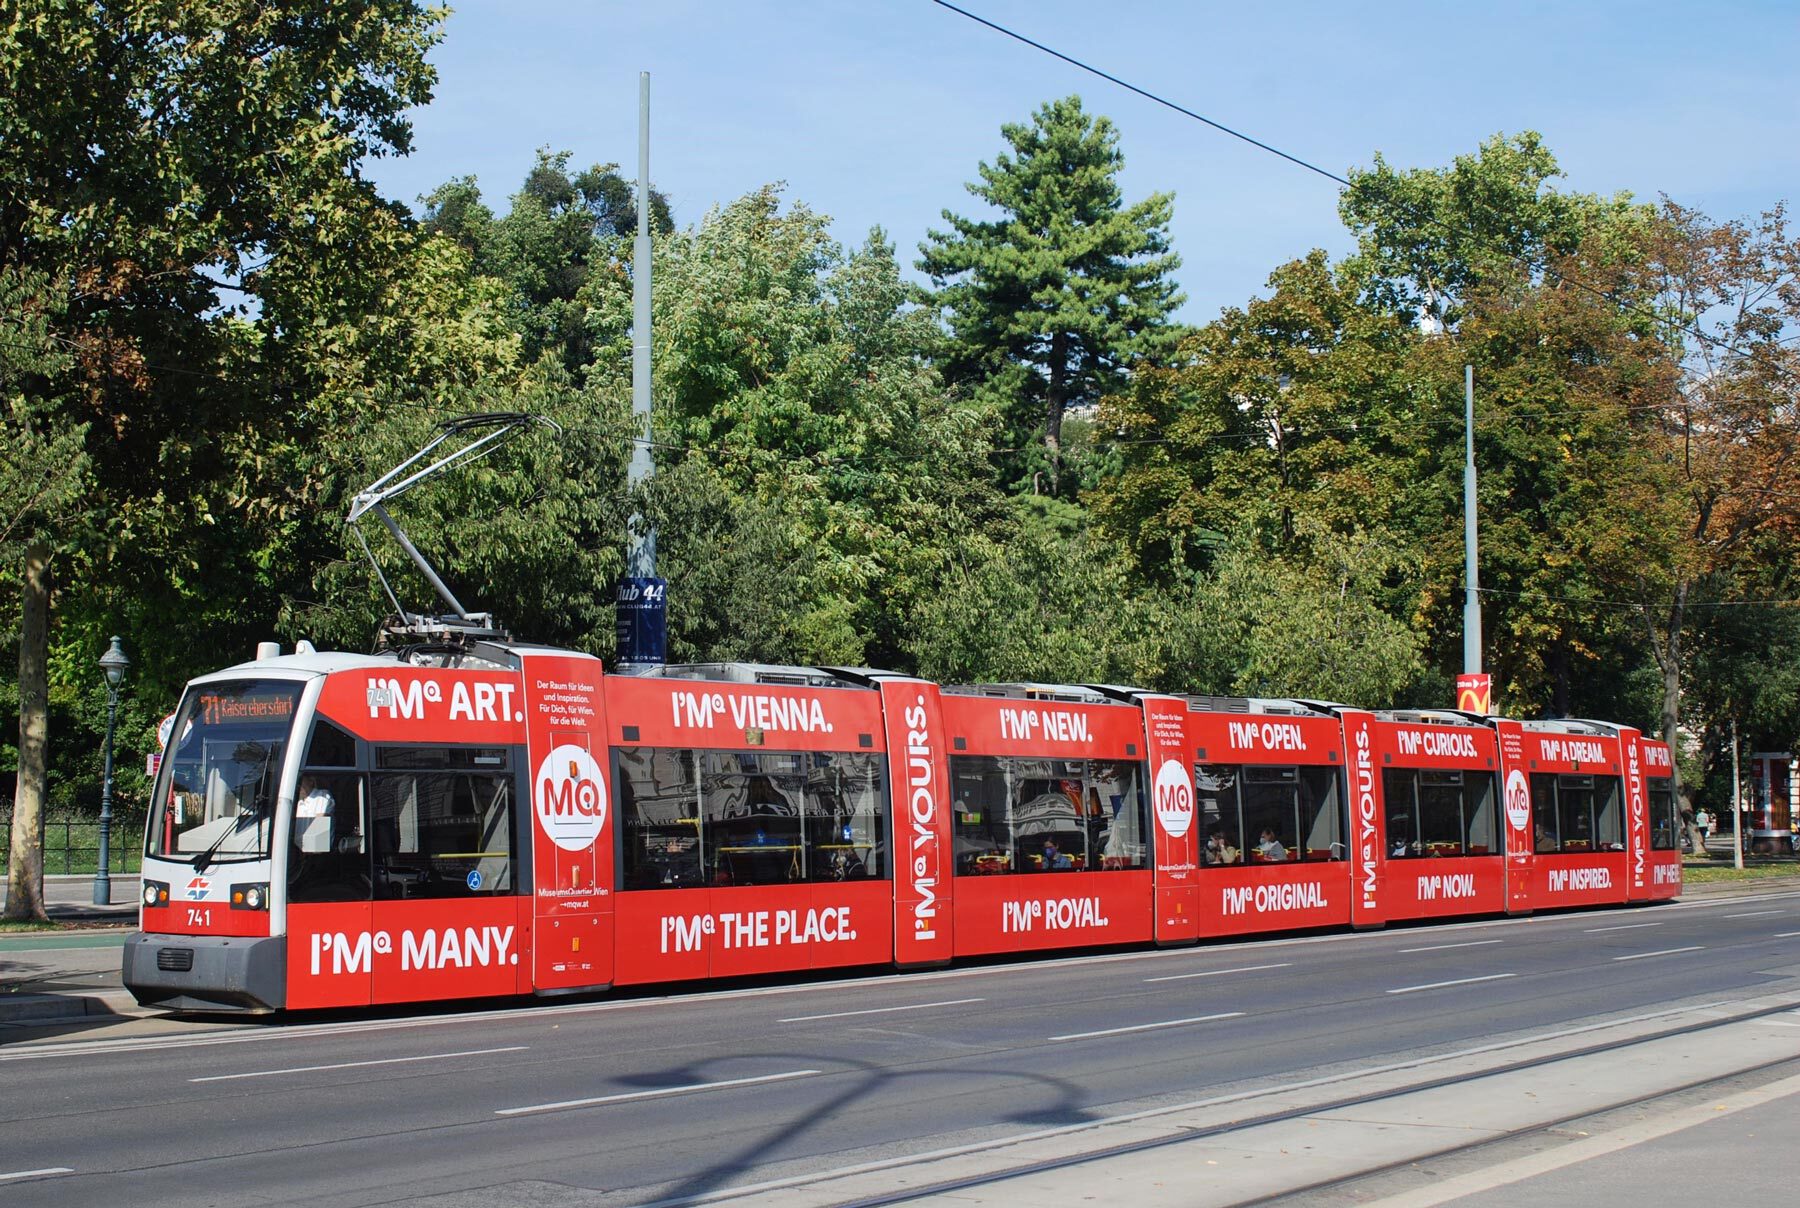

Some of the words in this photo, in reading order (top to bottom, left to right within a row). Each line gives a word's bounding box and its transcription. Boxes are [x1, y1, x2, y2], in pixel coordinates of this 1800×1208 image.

[643, 584, 663, 601] 44
[367, 689, 392, 705] 741
[537, 680, 548, 689] Der
[550, 681, 567, 690] Raum
[568, 682, 577, 691] für
[578, 683, 594, 692] Ideen
[544, 693, 556, 701] und
[557, 693, 590, 704] Inspiration.
[201, 695, 220, 725] 71
[222, 696, 293, 717] Kaiserebersdorf
[450, 682, 523, 722] ART.
[539, 704, 550, 712] Für
[551, 705, 567, 714] Dich,
[568, 705, 577, 714] für
[577, 706, 595, 716] Wien,
[728, 695, 833, 733] VIENNA.
[550, 716, 559, 725] für
[560, 716, 570, 725] die
[571, 717, 587, 727] Welt.
[1042, 711, 1092, 742] NEW.
[1262, 724, 1306, 750] OPEN.
[1424, 732, 1477, 757] CURIOUS.
[1562, 741, 1569, 761] A
[1570, 742, 1605, 763] DREAM.
[904, 695, 935, 848] YOURS.
[1356, 723, 1375, 839] YOURS.
[1627, 737, 1643, 833] YOURS.
[544, 777, 601, 819] MQ
[1160, 783, 1191, 813] MQ
[538, 887, 592, 897] MuseumsQuartier
[594, 887, 608, 896] Wien
[1443, 874, 1475, 898] NOW.
[1570, 868, 1611, 889] INSPIRED.
[1255, 882, 1327, 912] ORIGINAL.
[188, 909, 209, 925] 741
[720, 912, 768, 948] THE
[776, 907, 856, 944] PLACE.
[1046, 898, 1108, 929] ROYAL.
[402, 926, 517, 970] MANY.
